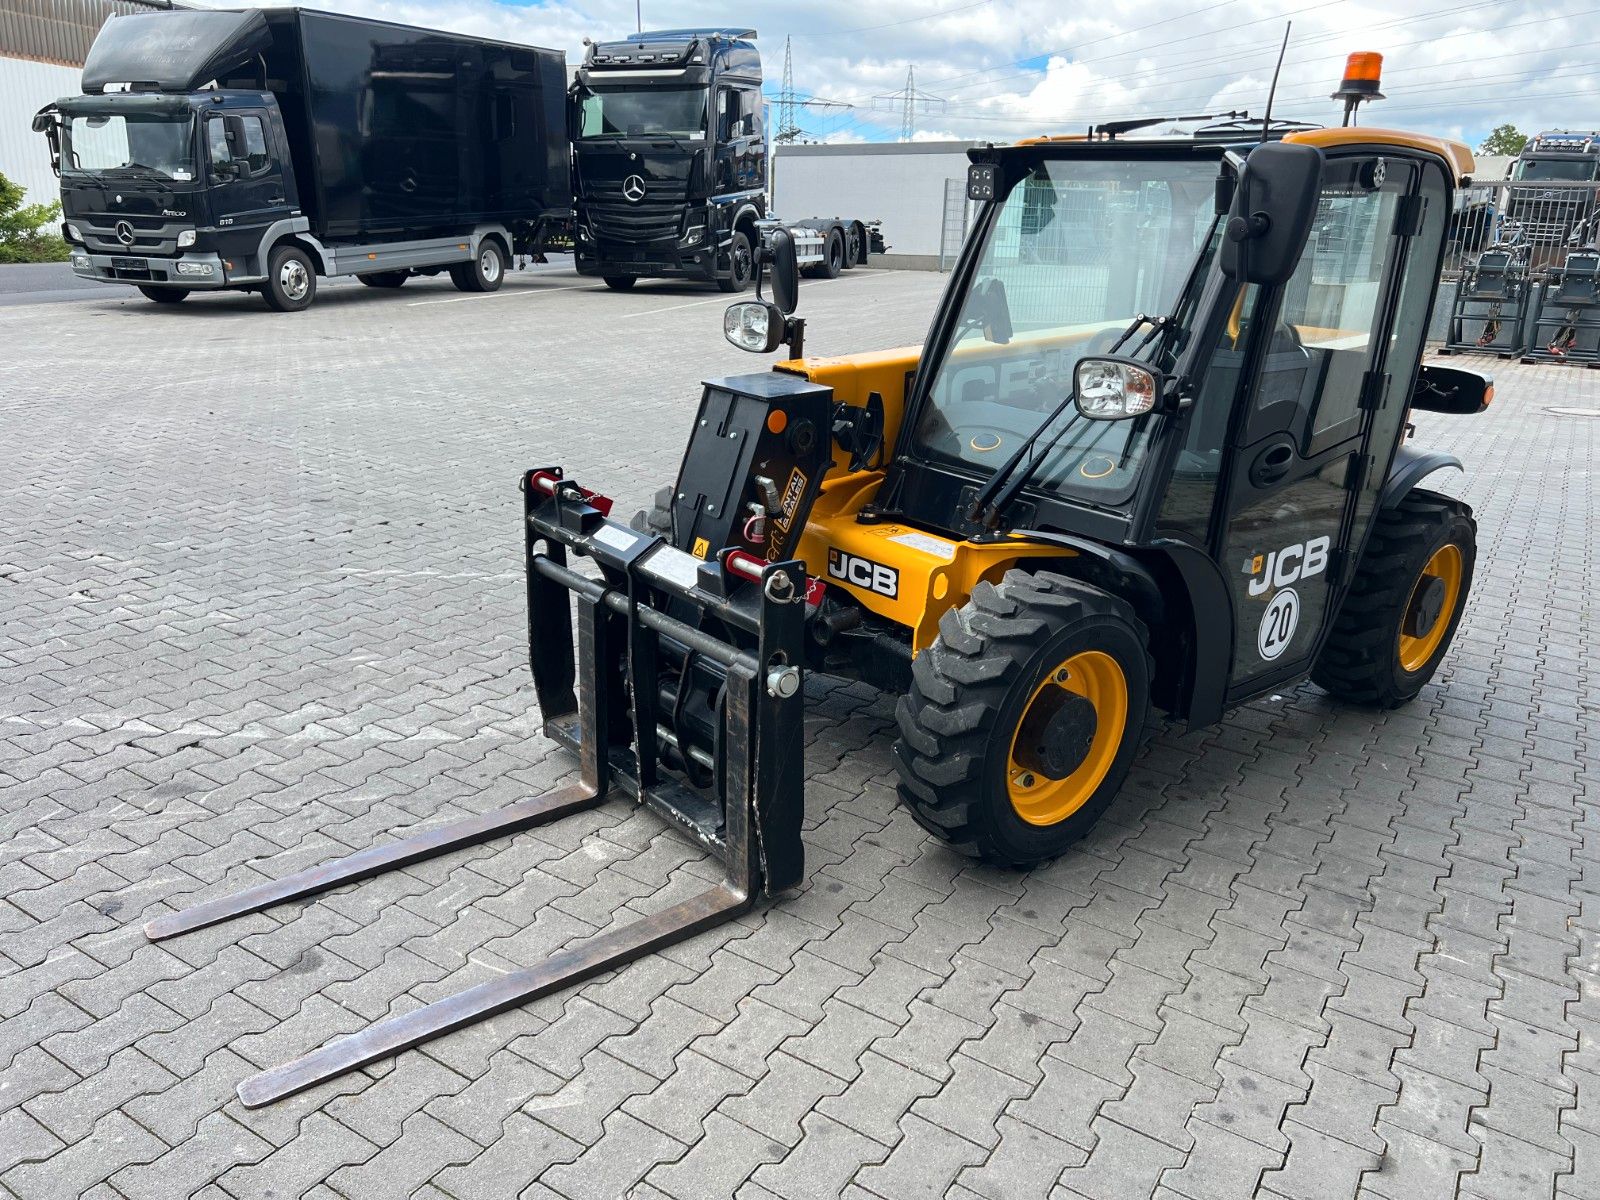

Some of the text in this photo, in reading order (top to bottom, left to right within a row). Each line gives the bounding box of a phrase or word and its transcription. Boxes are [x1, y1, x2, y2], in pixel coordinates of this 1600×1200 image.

[786, 477, 804, 517] SALES
[829, 550, 897, 597] JCB
[1248, 535, 1331, 597] JCB
[1264, 601, 1293, 648] 20
